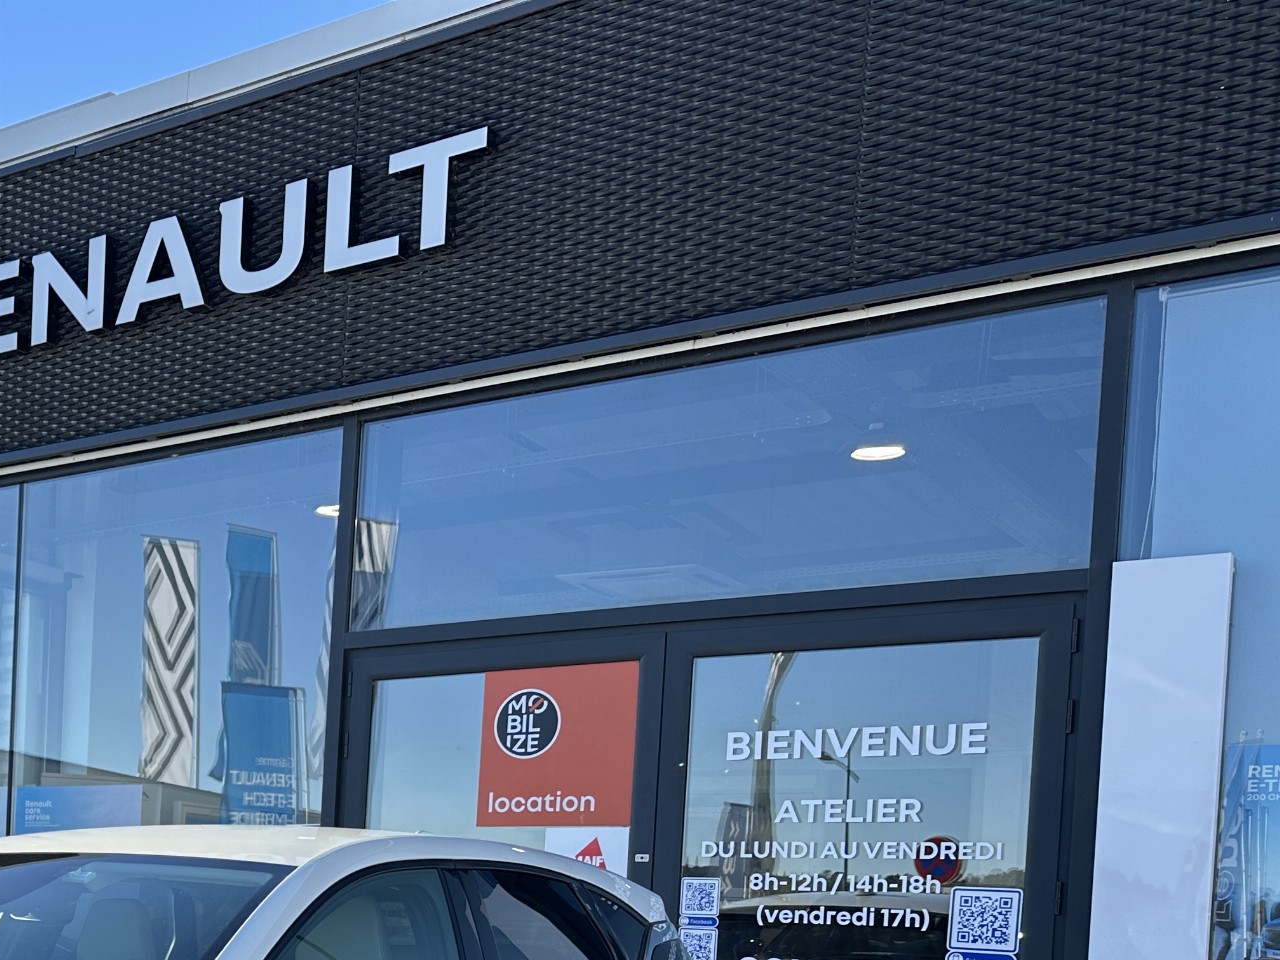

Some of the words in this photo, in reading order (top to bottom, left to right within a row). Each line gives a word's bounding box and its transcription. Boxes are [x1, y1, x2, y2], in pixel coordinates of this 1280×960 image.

[725, 722, 989, 761] BIENVENUE
[1246, 793, 1266, 801] 200
[1247, 779, 1280, 793] E-T
[24, 800, 53, 808] Renault
[488, 791, 596, 813] location
[774, 798, 924, 823] ATELIER
[700, 841, 735, 858] DU
[740, 841, 816, 860] LUNDI
[821, 841, 859, 860] AU
[863, 841, 1003, 861] VENDREDI
[749, 872, 827, 893] 8h-12h
[847, 874, 942, 894] 14h-18h
[756, 904, 876, 928] (vendredi
[880, 908, 931, 932] 17h)
